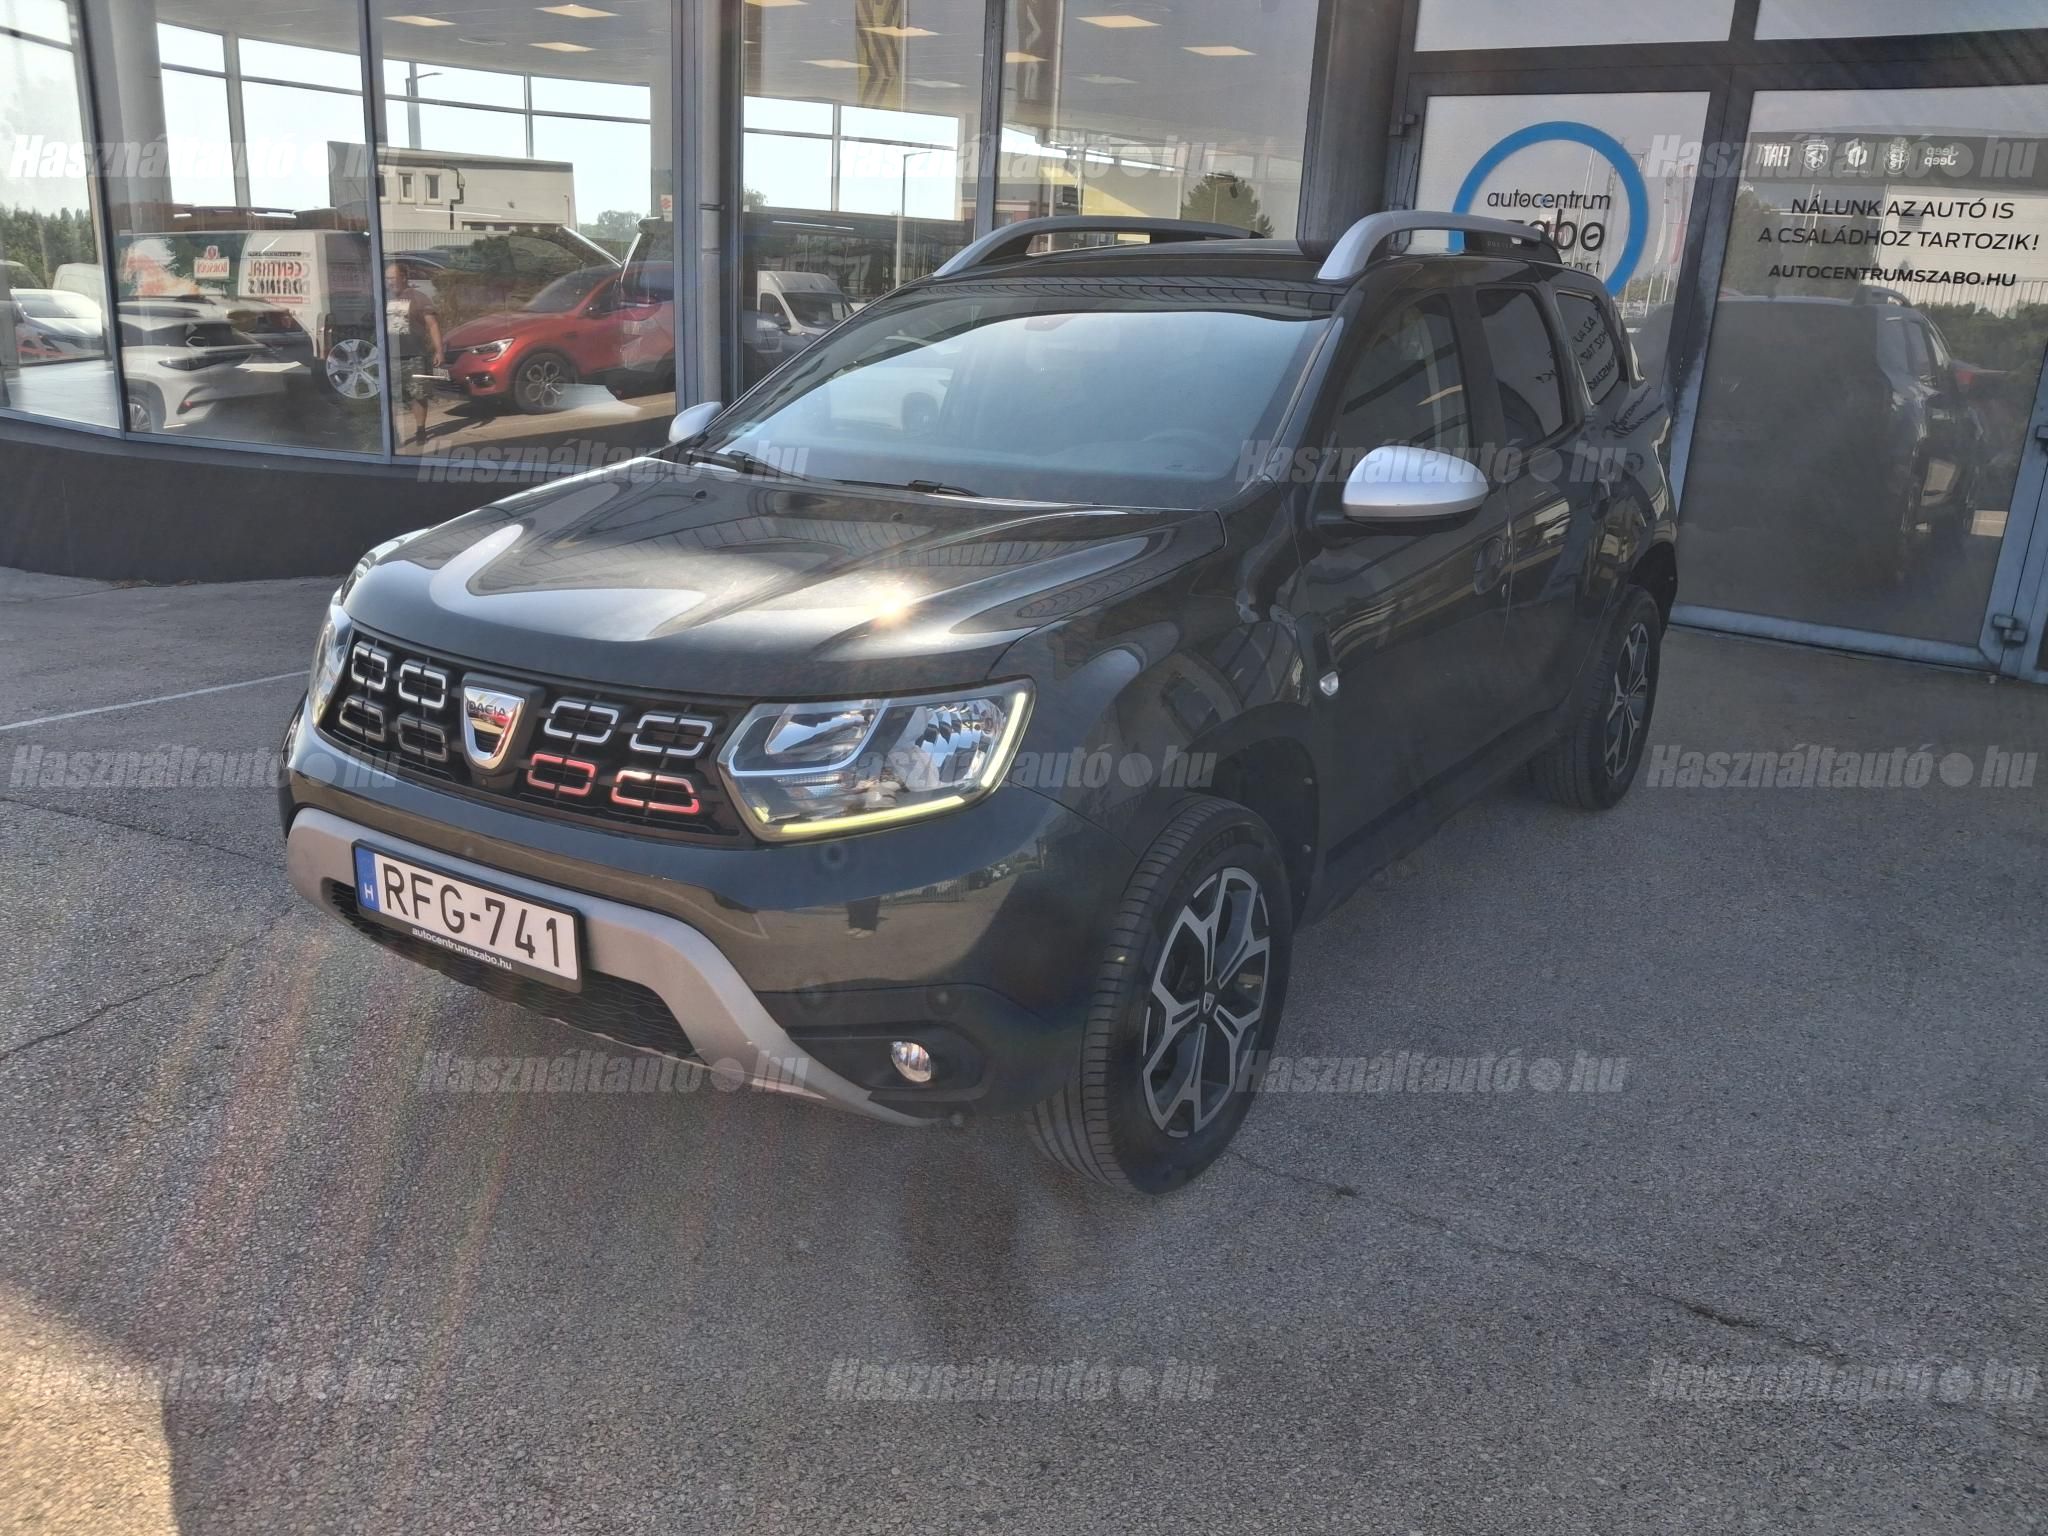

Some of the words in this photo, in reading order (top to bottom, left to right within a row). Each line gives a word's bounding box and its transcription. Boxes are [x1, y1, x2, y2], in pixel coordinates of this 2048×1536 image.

[1487, 189, 1611, 210] autocentrum
[1791, 194, 1882, 217] NÁLUNK
[1886, 200, 1917, 218] AZ
[1920, 197, 1987, 219] AUTÓ
[1993, 202, 2015, 219] IS
[1758, 227, 1772, 243] A
[1777, 224, 1911, 247] CSALÁDHOZ
[1917, 231, 2040, 251] TARTOZIK!
[1768, 264, 2017, 287] AUTOCENTRUMSZABO.HU
[469, 701, 506, 716] DACIA
[364, 882, 374, 900] H
[382, 862, 561, 968] RFG-741
[412, 927, 513, 971] autocentrumszabo.hu
